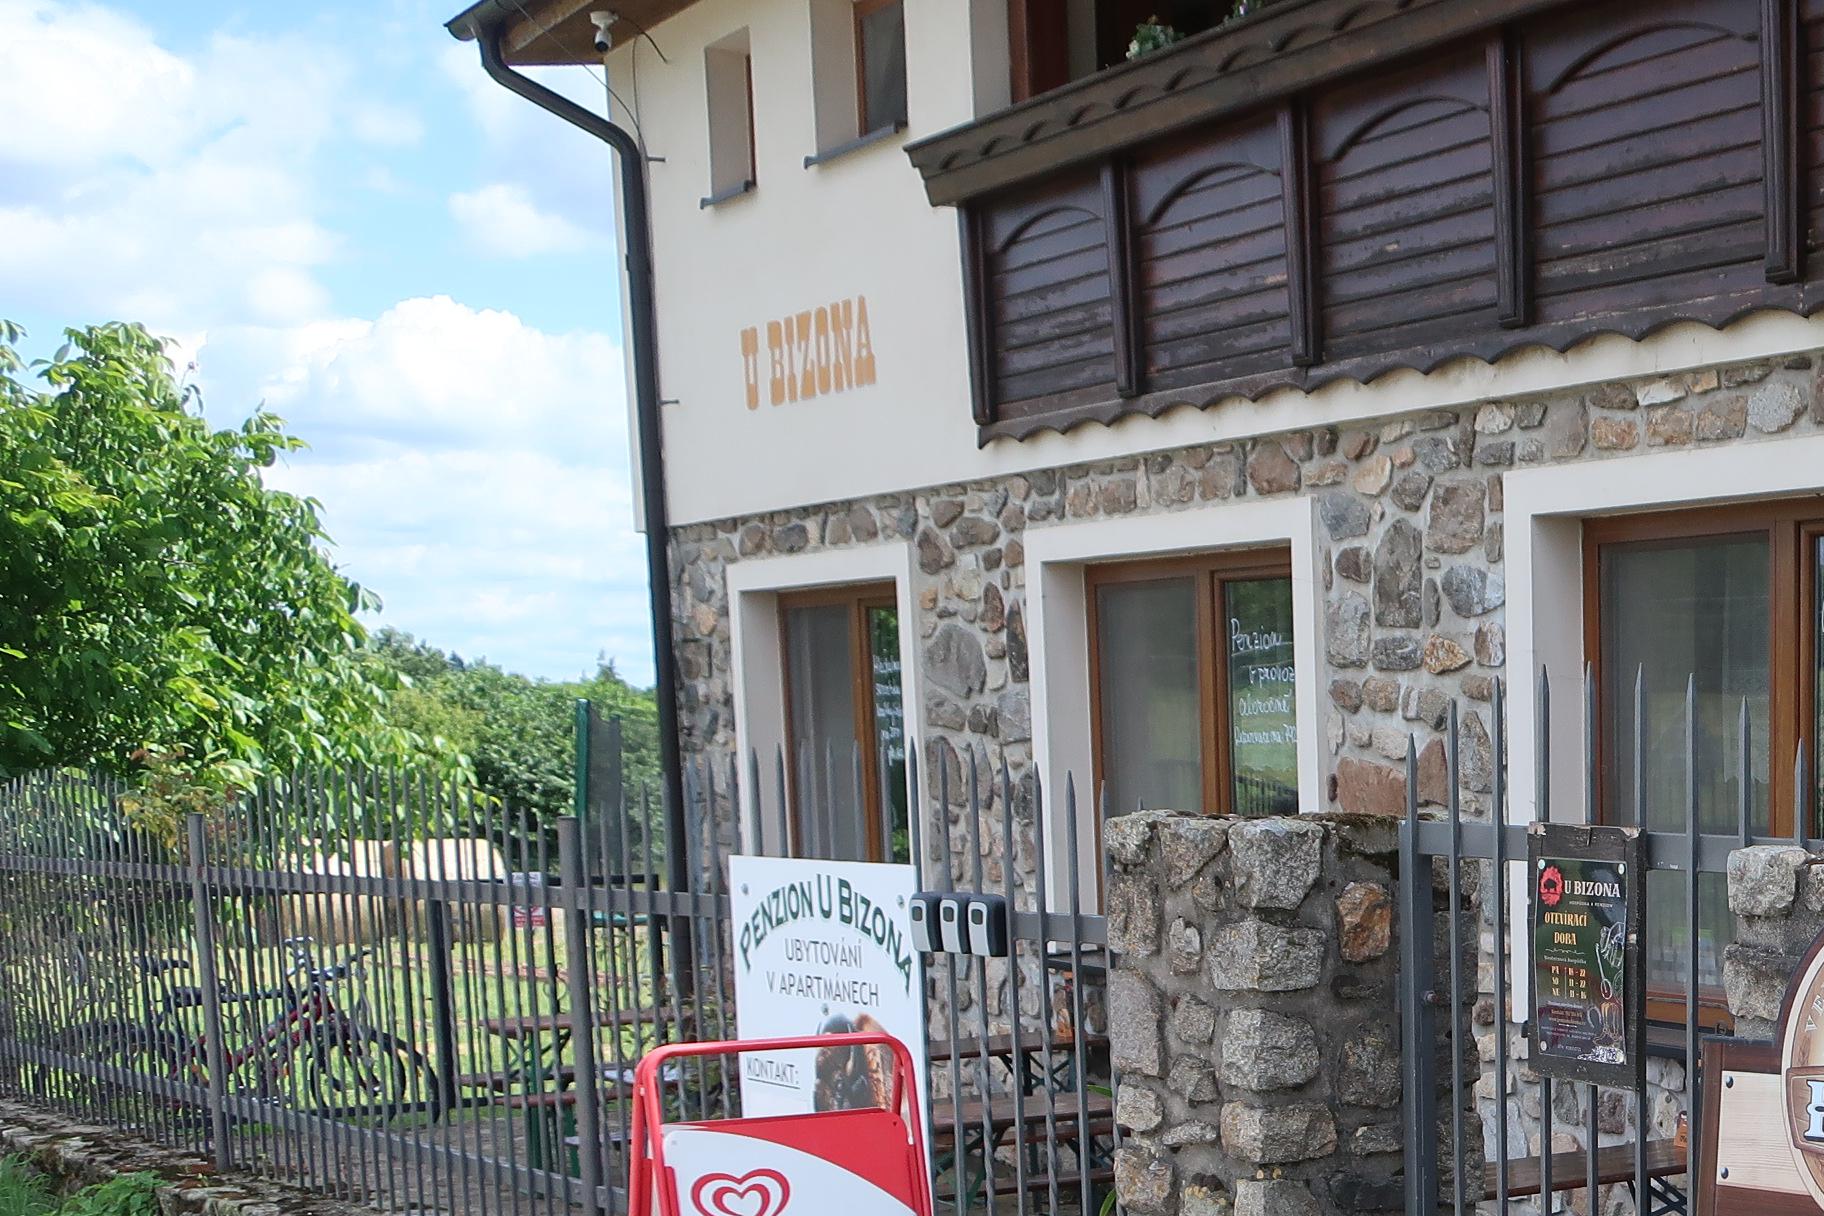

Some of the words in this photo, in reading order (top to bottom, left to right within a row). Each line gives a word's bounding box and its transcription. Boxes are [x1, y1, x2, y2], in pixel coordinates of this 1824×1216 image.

[740, 325, 759, 411] U
[766, 294, 877, 408] BIZONA
[1230, 618, 1282, 652] Penzion
[1564, 880, 1572, 894] U
[1573, 880, 1621, 898] BIZONA
[740, 880, 814, 973] PENZION
[816, 873, 833, 919] U
[838, 877, 913, 998] BIZONA
[784, 936, 863, 969] UBYTOVÁNÍ
[1554, 931, 1577, 945] DOBA
[766, 970, 775, 993] V
[779, 972, 880, 1008] APARTMÁNECH
